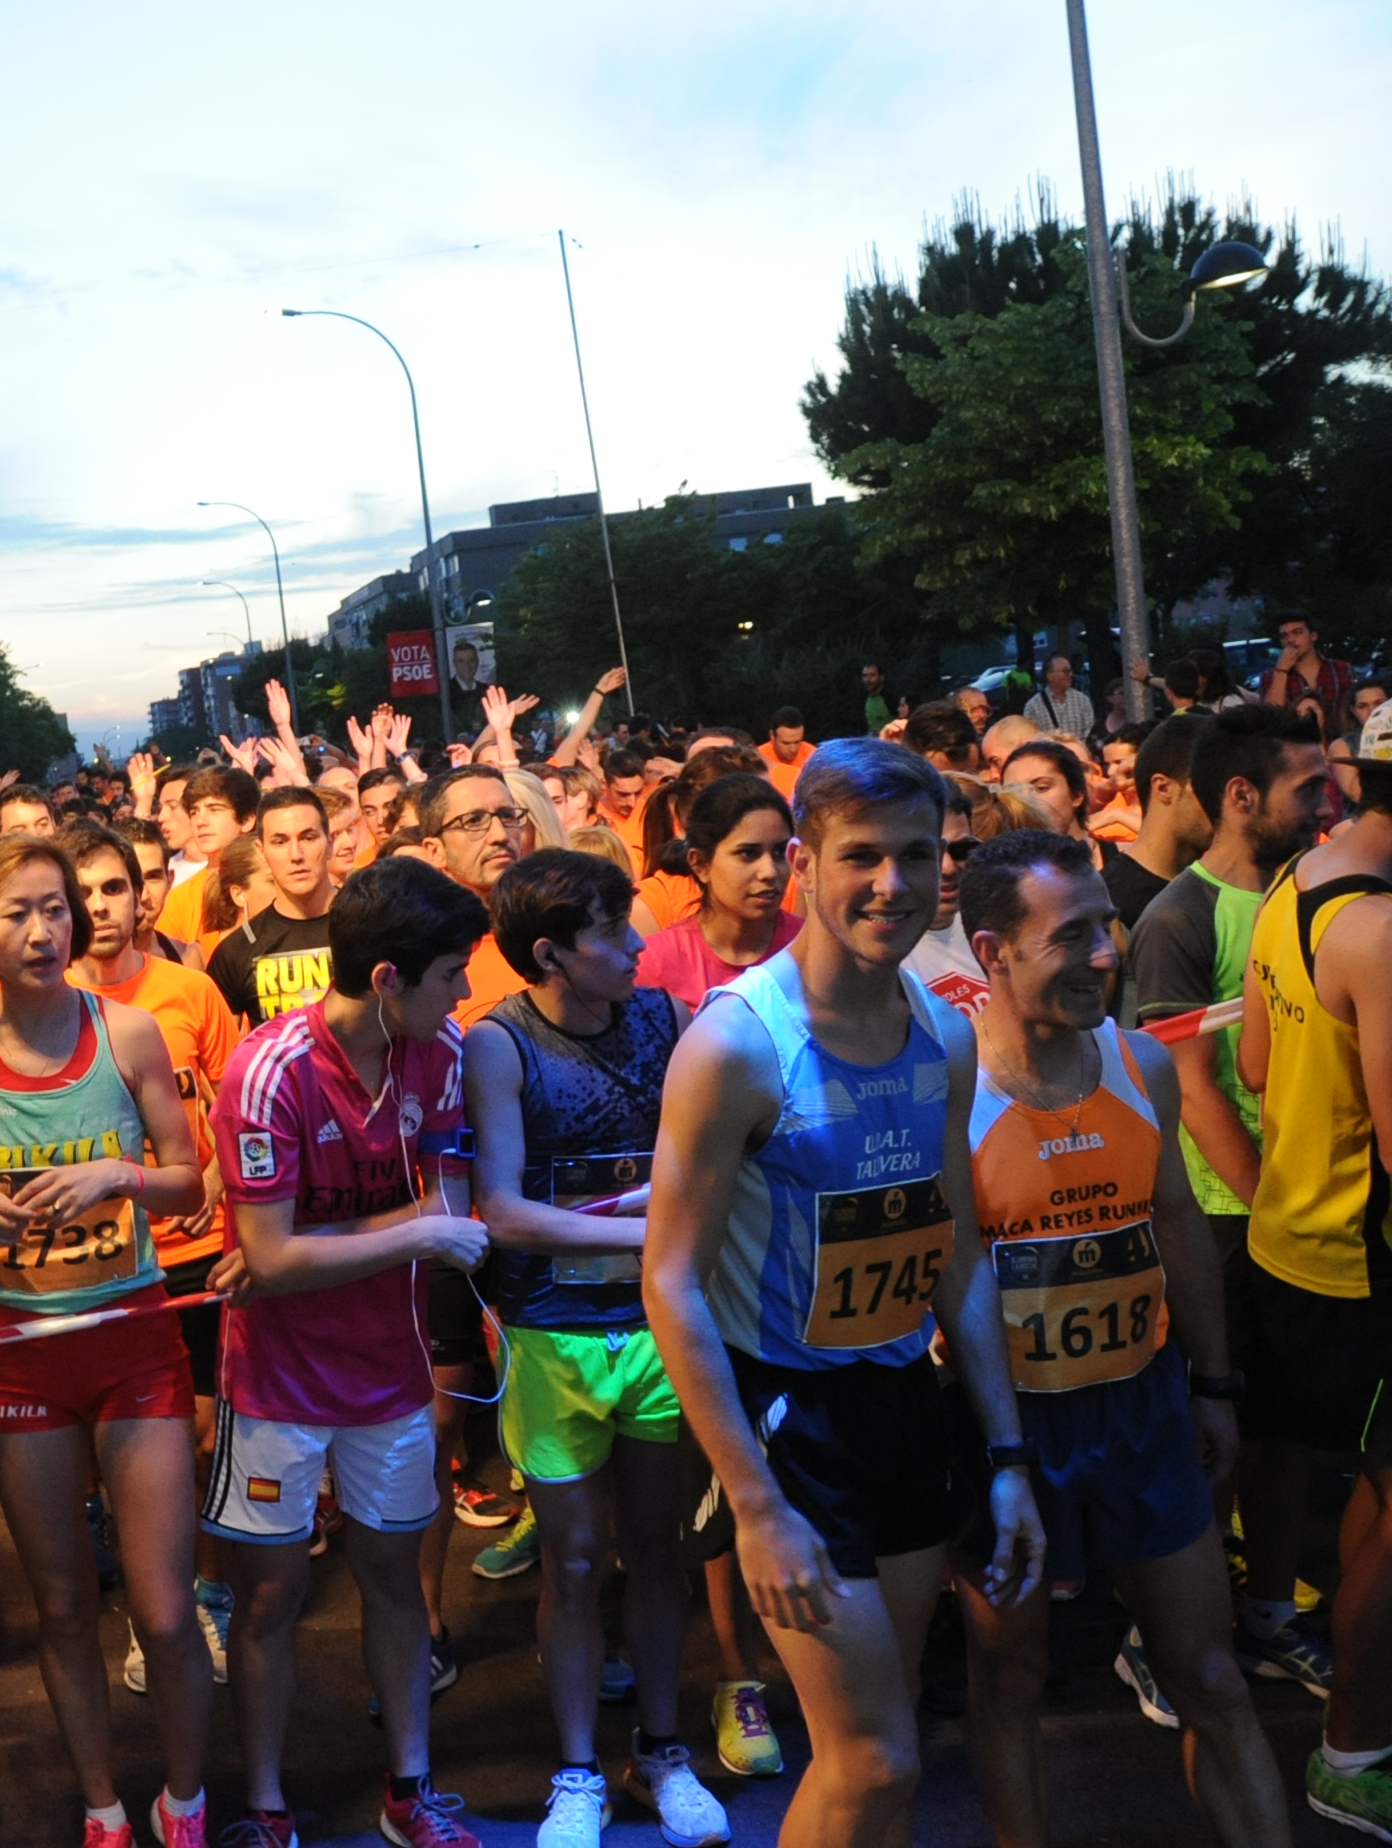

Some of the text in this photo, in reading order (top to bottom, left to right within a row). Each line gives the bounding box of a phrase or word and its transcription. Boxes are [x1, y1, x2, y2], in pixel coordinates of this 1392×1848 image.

[391, 645, 430, 662] VOTA
[392, 664, 433, 682] PSOE
[256, 951, 331, 997] RUN
[259, 992, 325, 1020] TR
[857, 1077, 908, 1101] Joma
[1038, 1132, 1104, 1161] Joma
[1050, 1182, 1119, 1206] GRUPO
[1040, 1206, 1094, 1231] REYES
[3, 1220, 124, 1270] 1738
[829, 1248, 943, 1320] 1745
[1021, 1294, 1152, 1361] 1618
